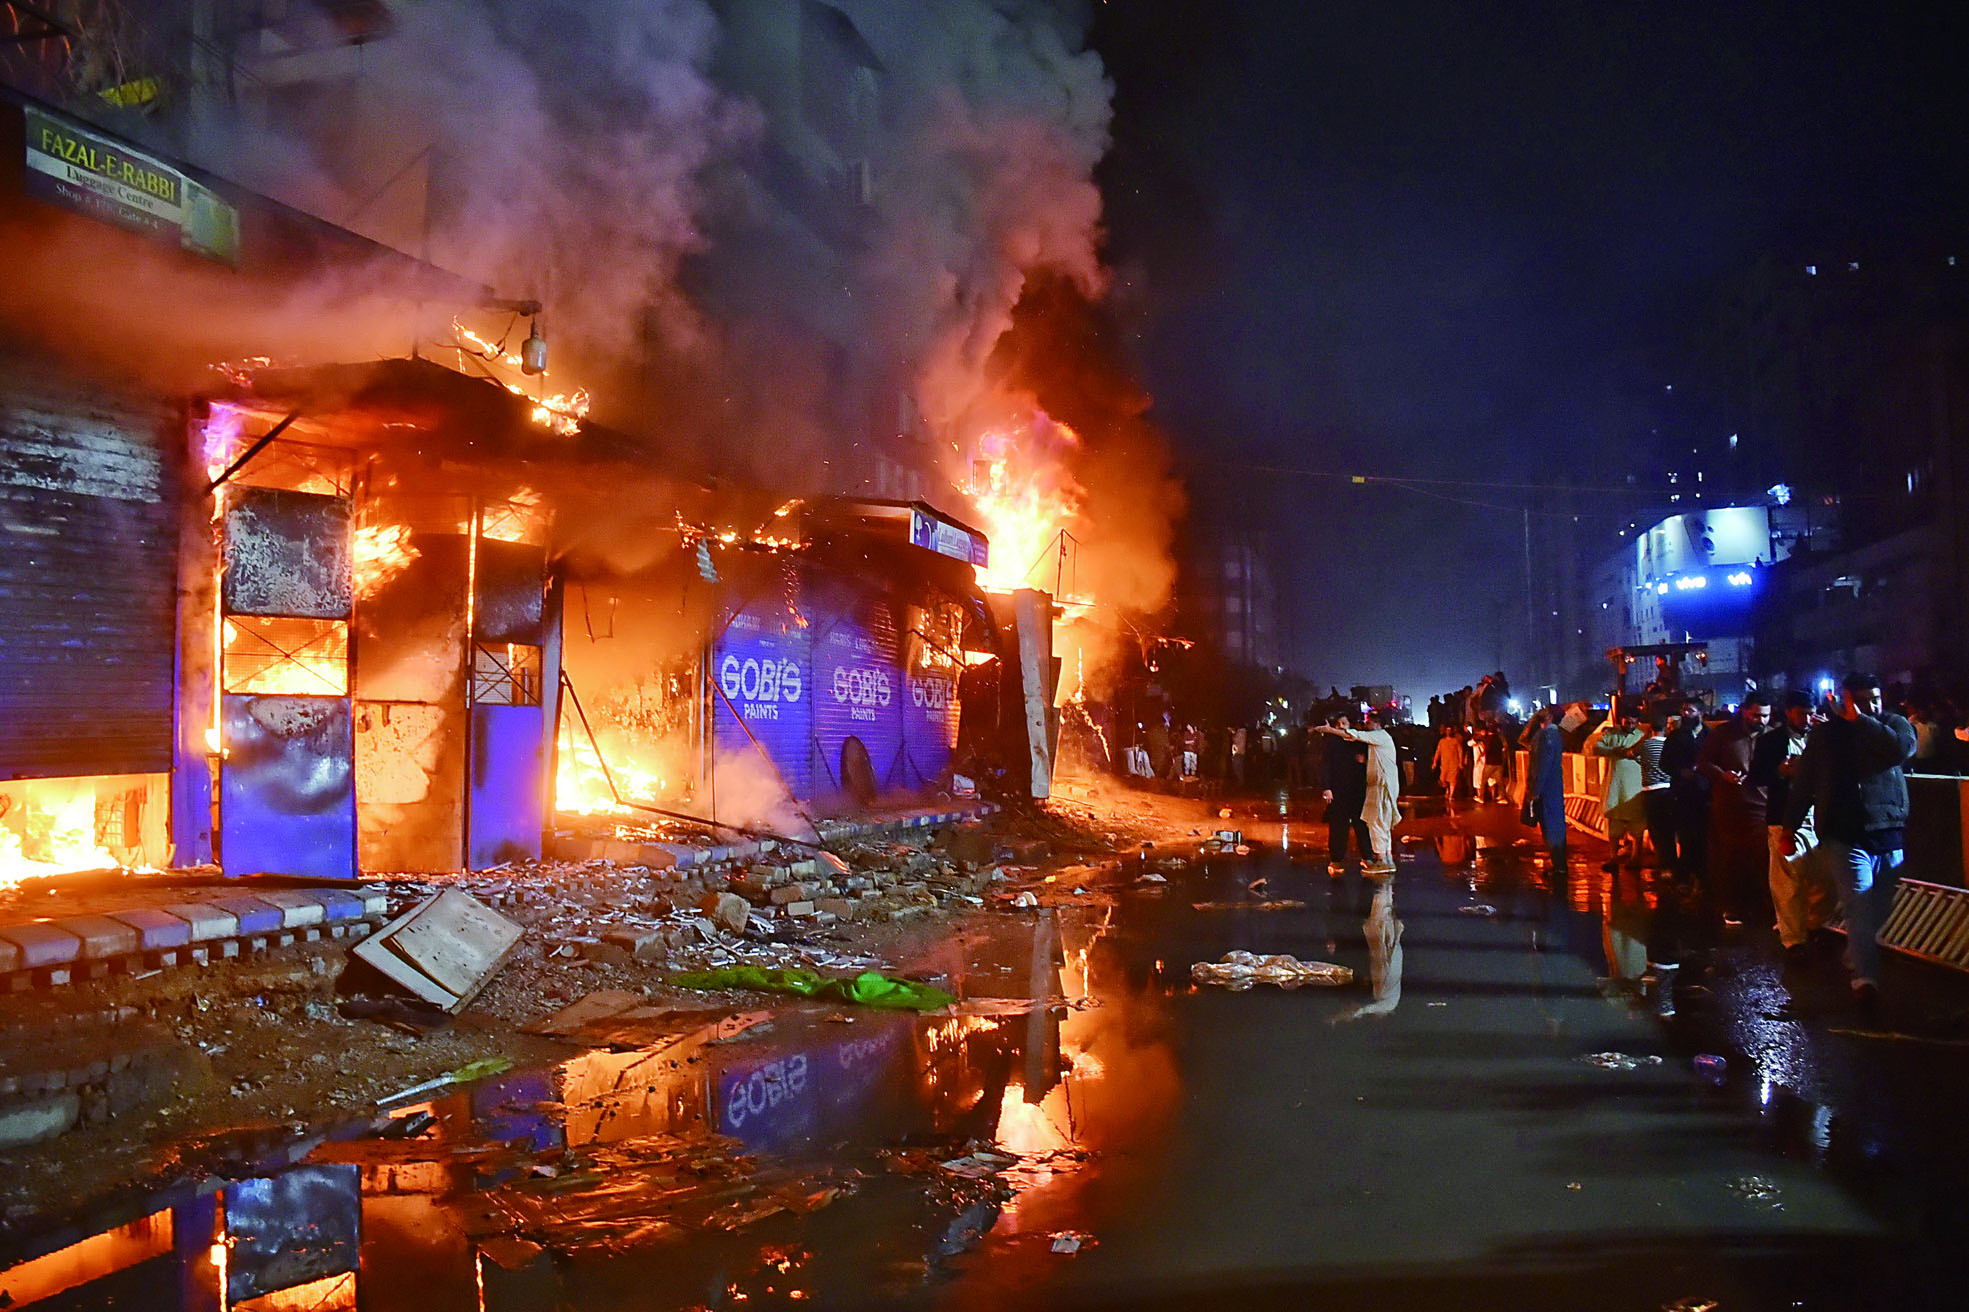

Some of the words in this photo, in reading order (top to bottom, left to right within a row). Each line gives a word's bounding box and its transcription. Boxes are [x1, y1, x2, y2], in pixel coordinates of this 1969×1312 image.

[41, 128, 176, 201] FAZAL-E-RABBI
[117, 186, 154, 209] Centre
[721, 655, 802, 703] GOBI'S
[833, 666, 891, 706] GOBI'S
[744, 703, 779, 720] PAINTS
[851, 707, 876, 721] PAINTS
